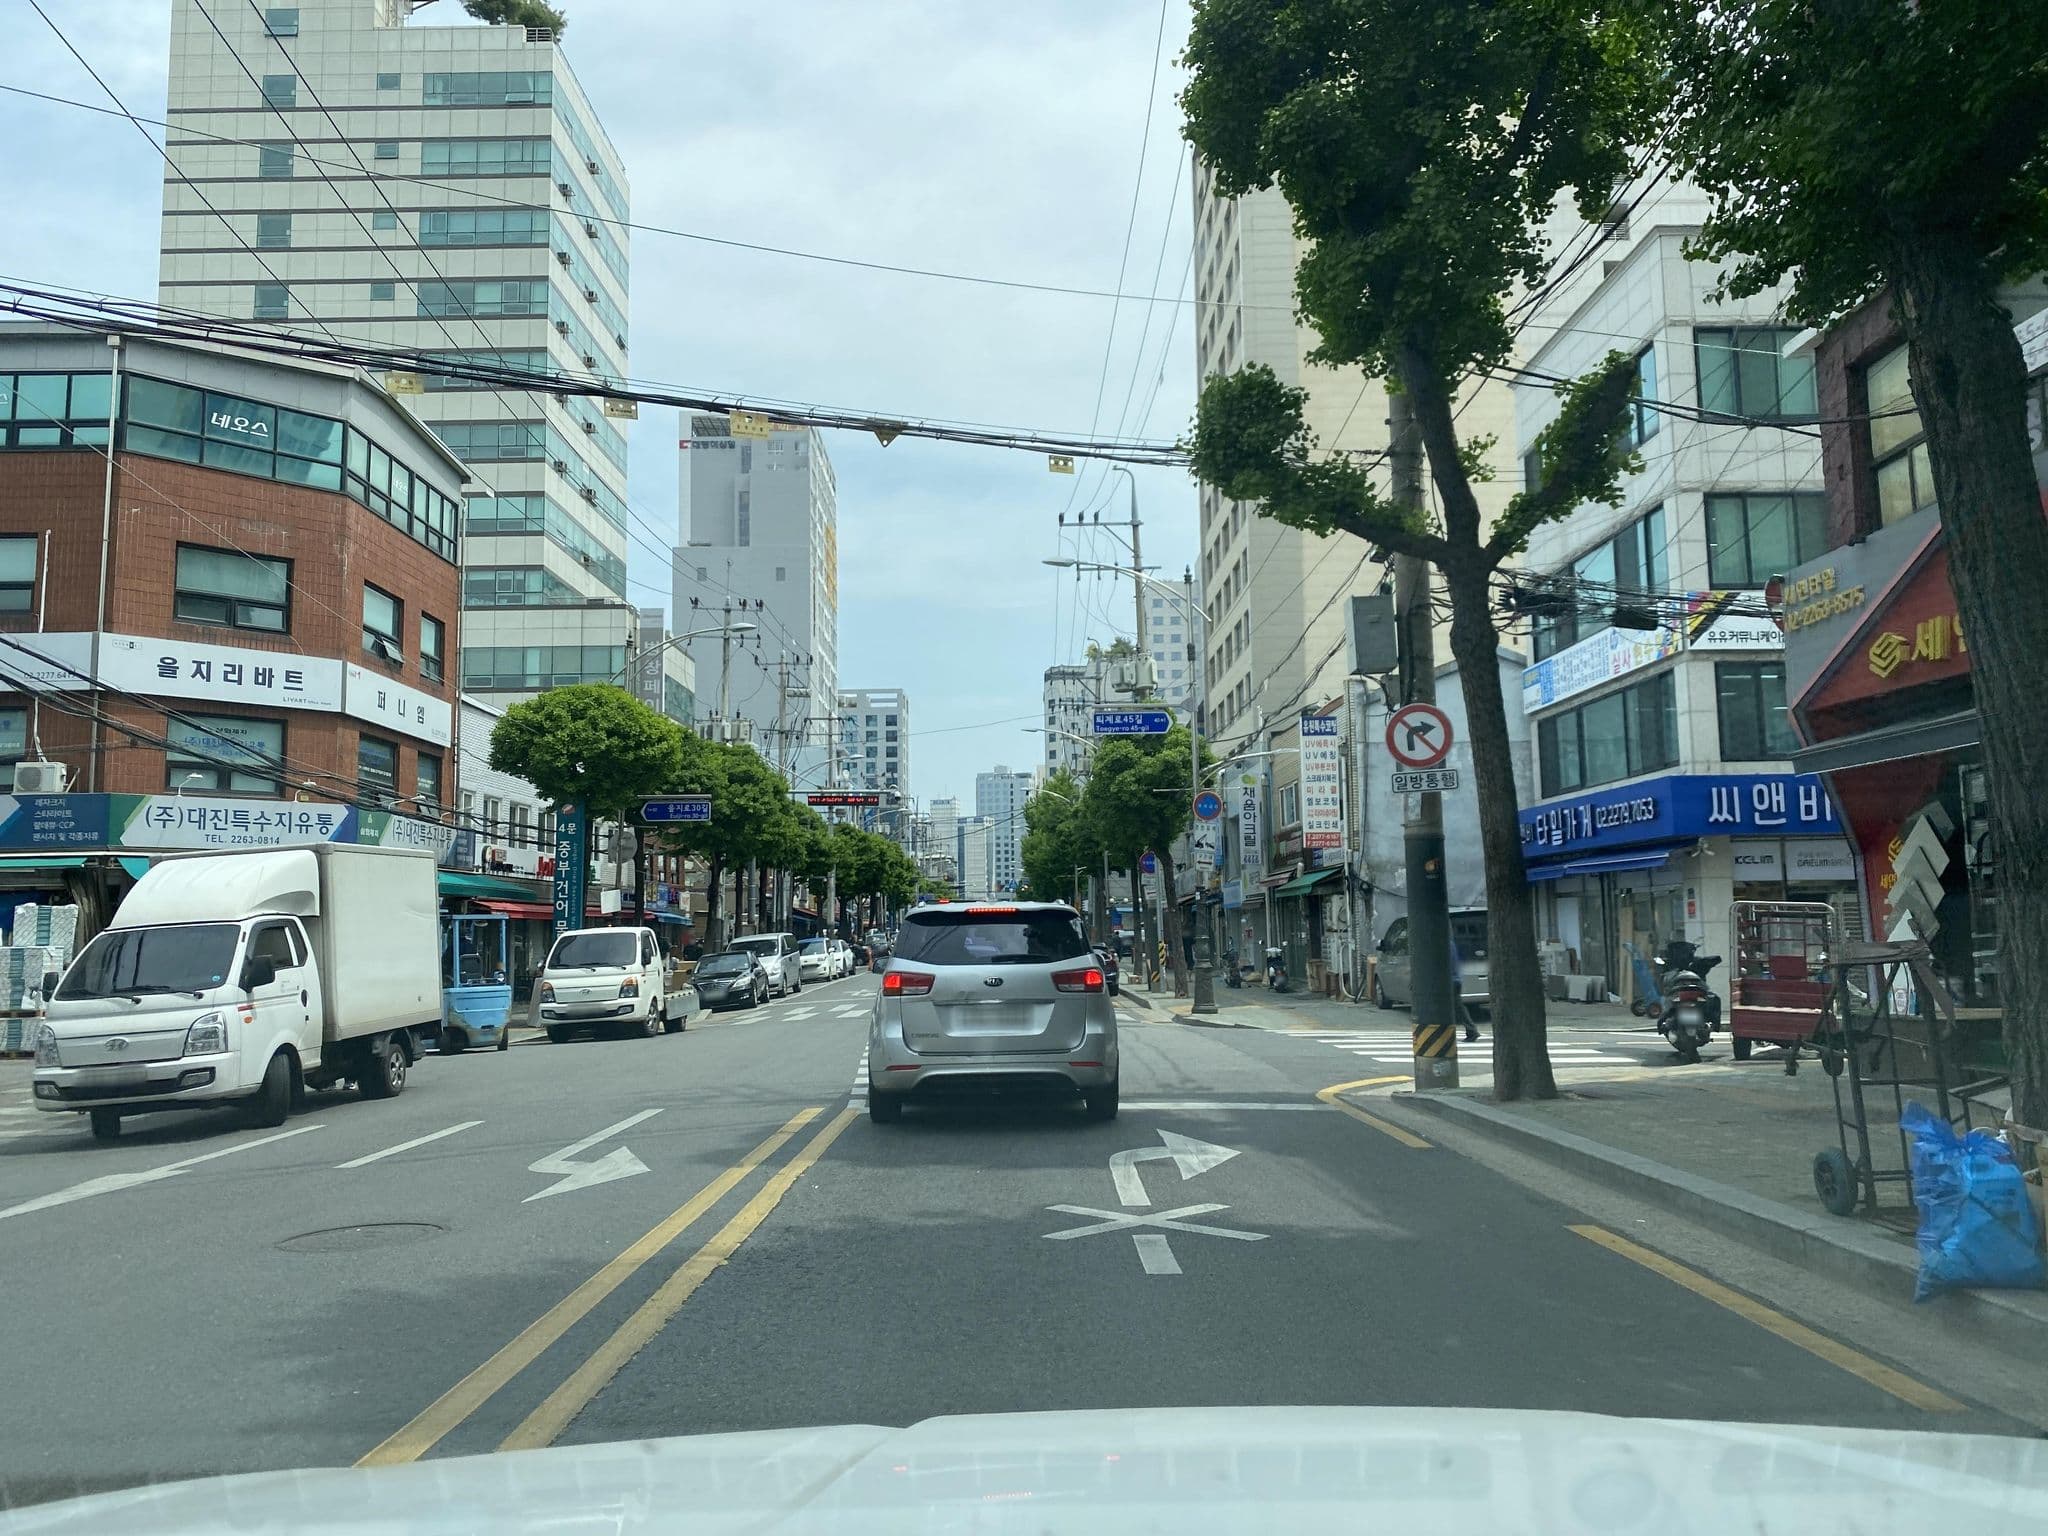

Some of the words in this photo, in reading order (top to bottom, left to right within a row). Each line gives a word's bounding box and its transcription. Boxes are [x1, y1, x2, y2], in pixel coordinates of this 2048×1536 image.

[210, 411, 269, 437] 네오스
[156, 656, 304, 692] 을지리바트
[1095, 714, 1143, 725] 퇴계로45길
[1394, 773, 1456, 791] 일방통행
[144, 805, 335, 836] (주)대진특수지유통
[1536, 803, 1593, 846] 타일가게
[204, 834, 228, 844] TEL.
[231, 835, 281, 845] 2263-0814
